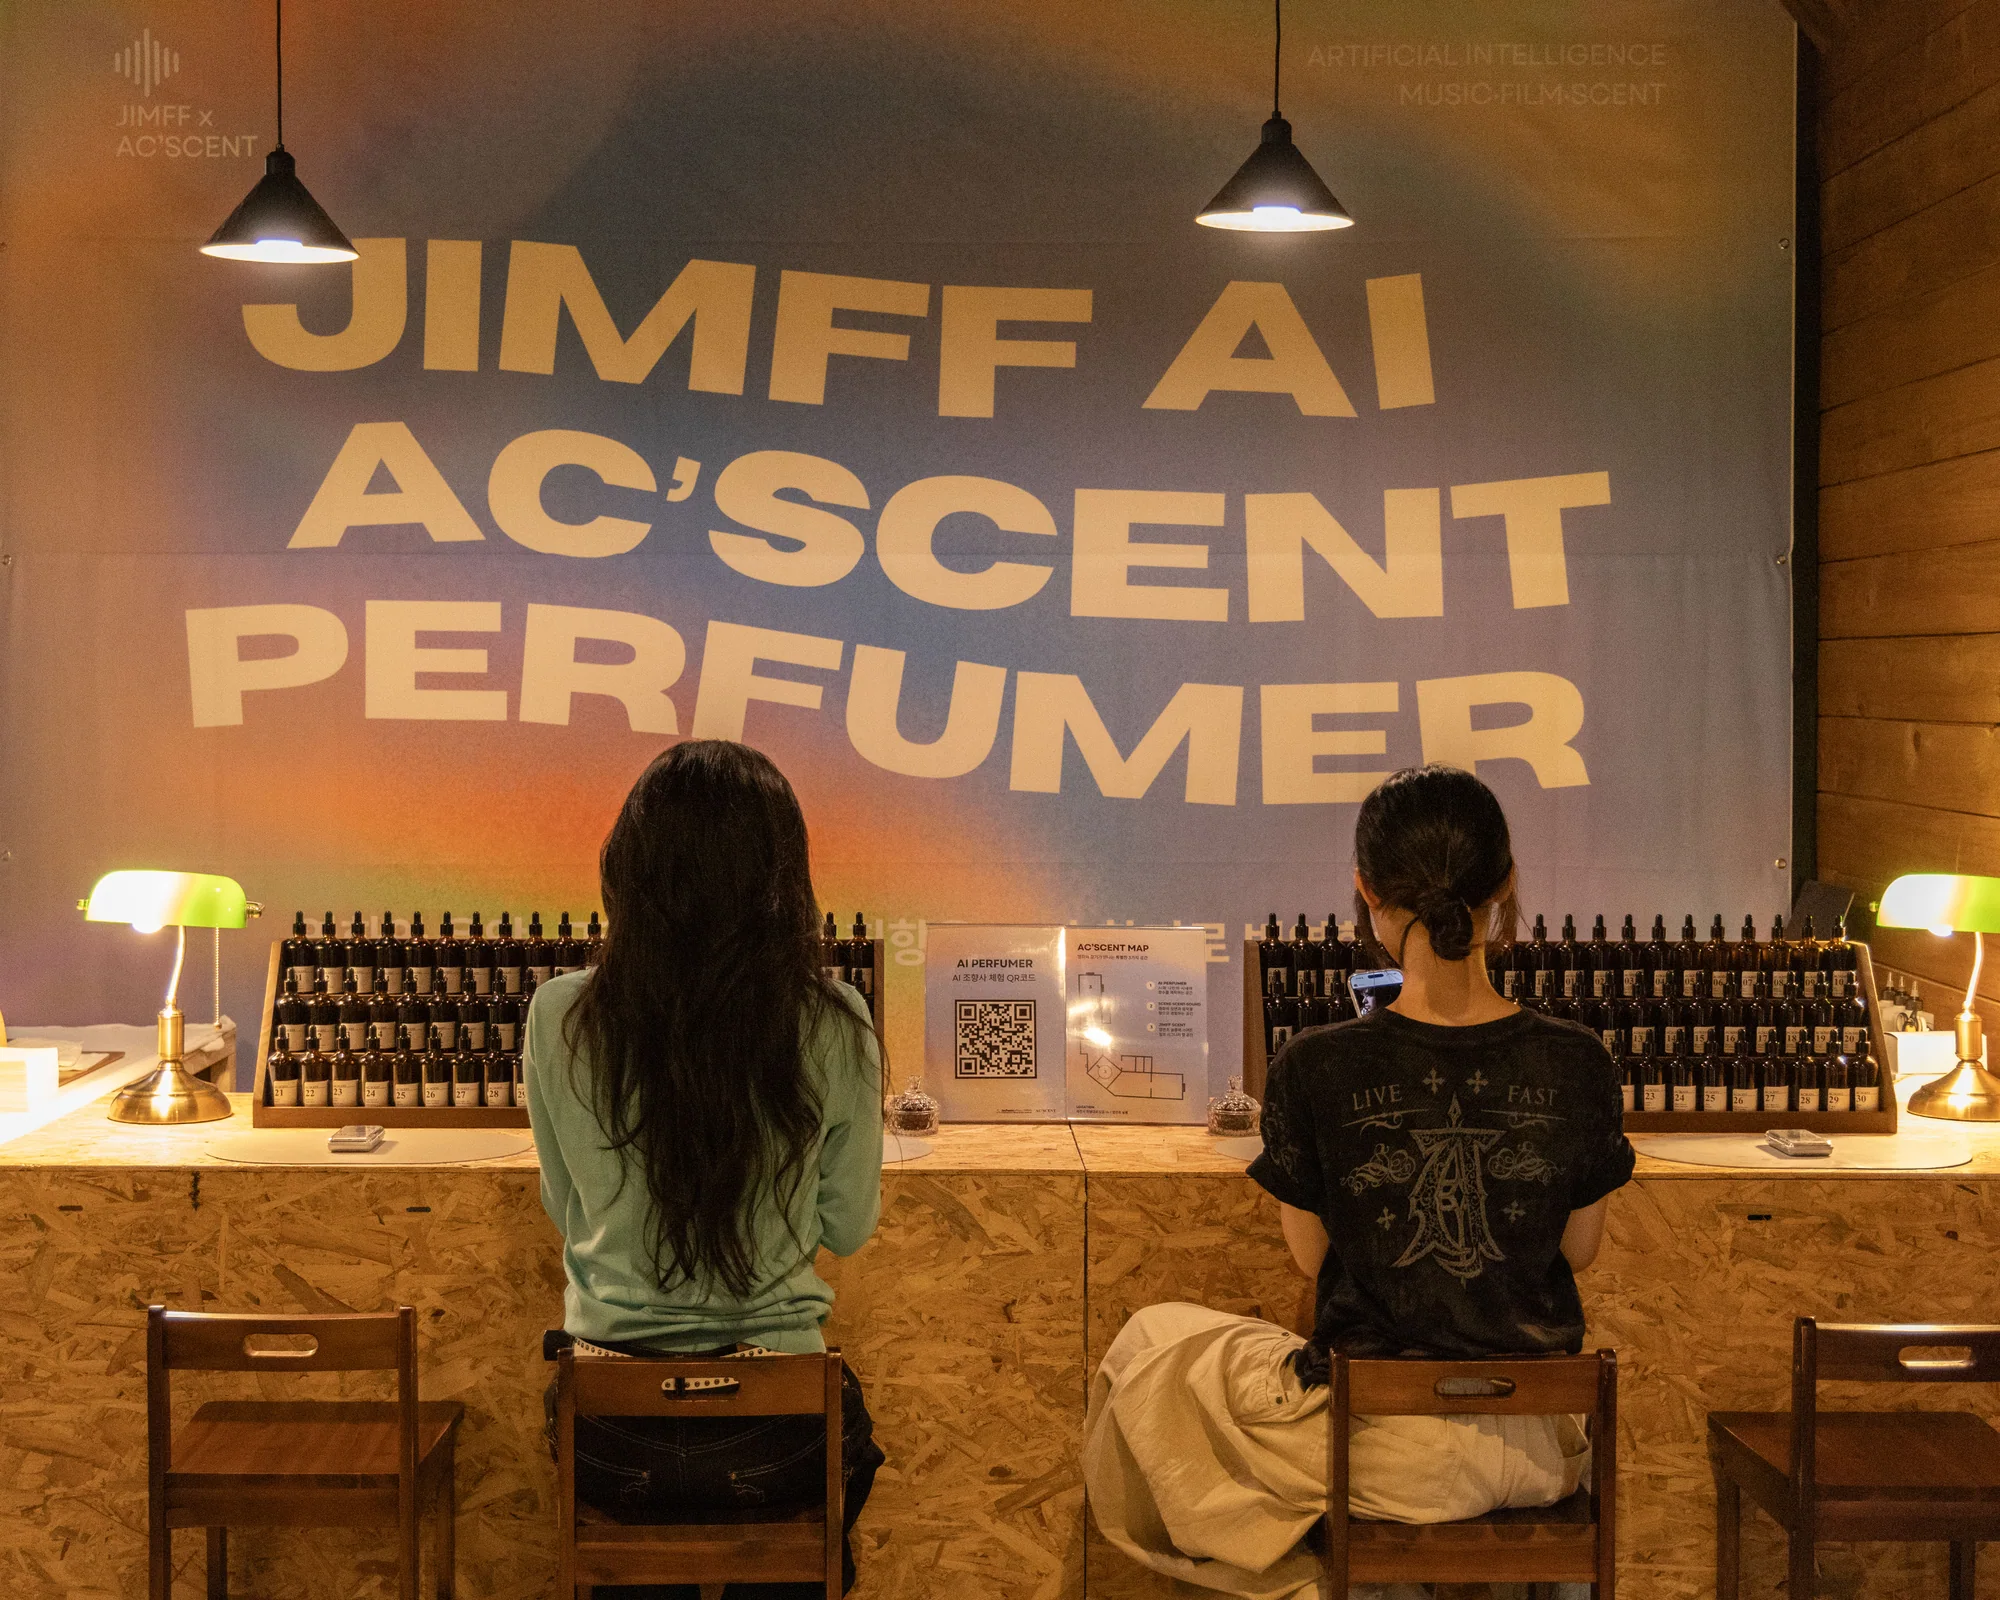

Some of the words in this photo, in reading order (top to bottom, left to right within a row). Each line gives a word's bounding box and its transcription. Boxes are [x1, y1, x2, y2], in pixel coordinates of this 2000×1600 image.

[1307, 44, 1459, 67] ARTIFICIAL
[1466, 43, 1668, 66] INTELLIGENCE
[115, 105, 191, 127] JIMFF
[242, 237, 1093, 418] JIMFF
[1141, 273, 1436, 418] AI
[185, 600, 1592, 806] PERFUMER
[1127, 944, 1149, 952] MAP
[957, 959, 968, 968] AI
[972, 959, 1033, 968] PERFUMER
[963, 974, 986, 982] 조향사
[989, 974, 1004, 982] 체험
[1006, 974, 1036, 982] QR코드
[1352, 1084, 1402, 1111] LIVE
[1508, 1084, 1558, 1107] FAST
